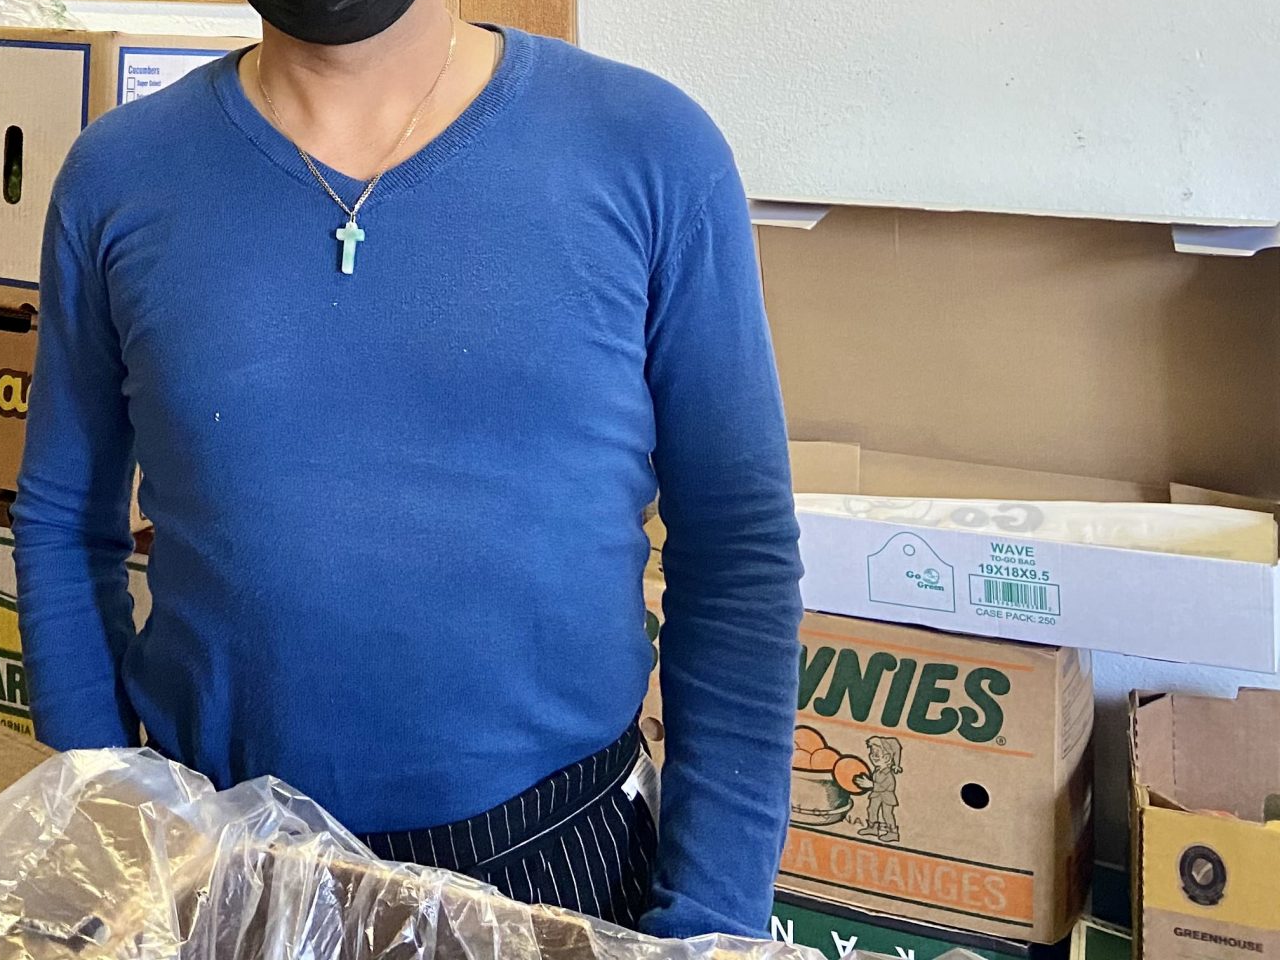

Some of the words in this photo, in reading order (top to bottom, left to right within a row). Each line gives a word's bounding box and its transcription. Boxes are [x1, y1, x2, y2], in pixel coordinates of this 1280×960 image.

[128, 65, 160, 75] Cucumbers
[990, 542, 1035, 557] WAVE
[991, 554, 1016, 565] TO-GO
[1018, 558, 1036, 567] BAG
[906, 570, 921, 580] Go
[979, 563, 1050, 581] 19X18X9.5
[917, 581, 945, 592] Green
[976, 607, 1003, 619] CASE
[1005, 611, 1037, 623] PACK:
[1038, 616, 1056, 626] 250
[830, 833, 1007, 913] ORANGES
[1173, 927, 1264, 953] GREENHOUSE
